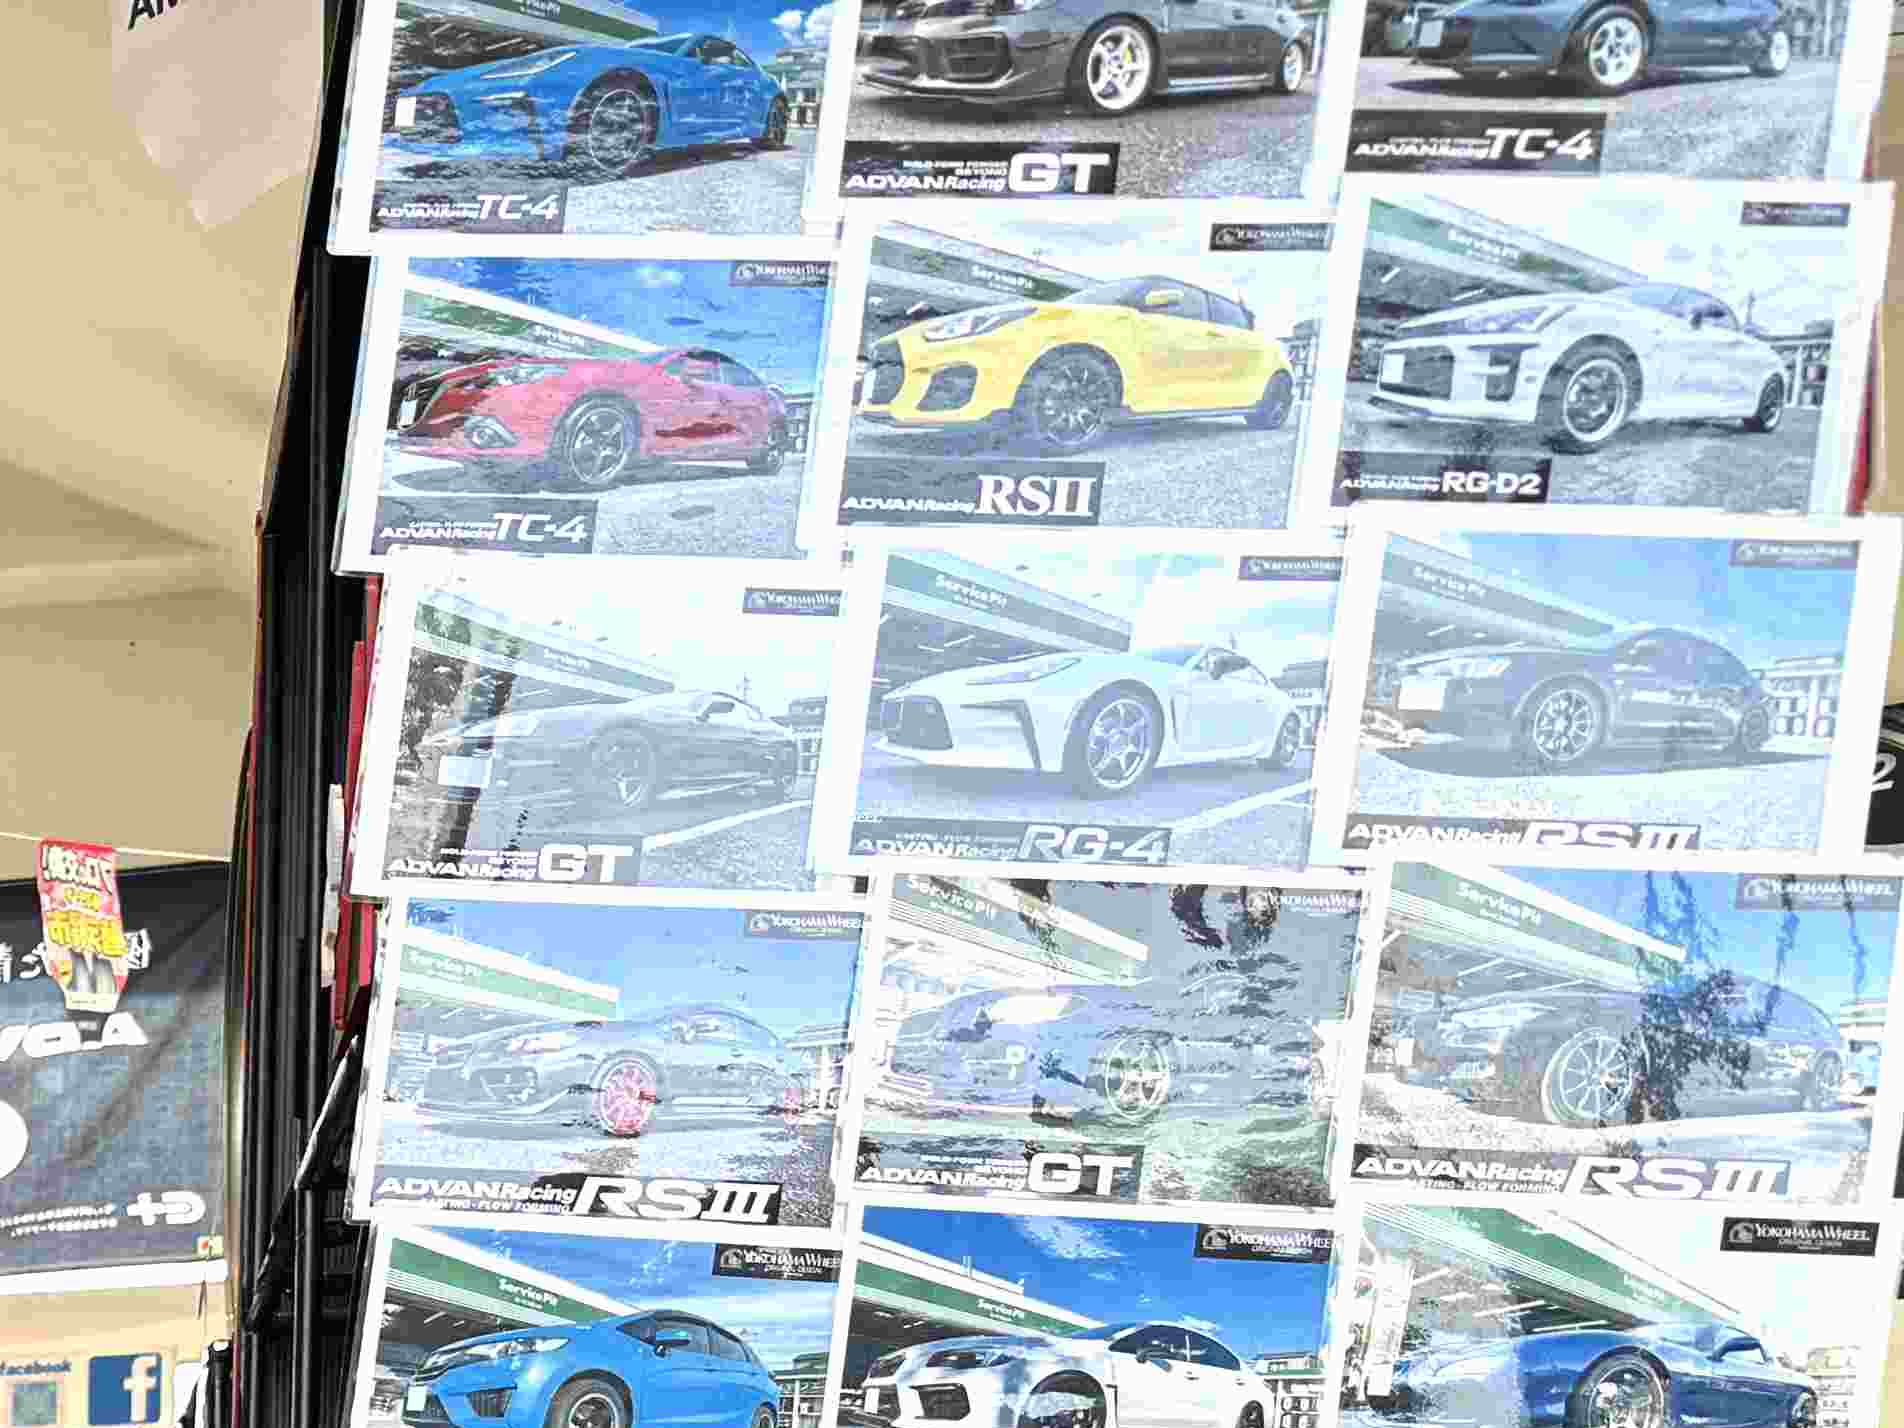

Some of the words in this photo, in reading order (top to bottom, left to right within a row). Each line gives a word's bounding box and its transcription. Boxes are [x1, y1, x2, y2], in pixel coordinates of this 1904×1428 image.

[1484, 128, 1596, 161] TC-4
[1008, 153, 1111, 193] GT
[478, 195, 560, 220] TC-4
[1442, 471, 1544, 497] RG-D2
[494, 513, 589, 542] TC-4
[1020, 824, 1169, 864] RG-4
[537, 842, 635, 883] GT
[1028, 1150, 1137, 1196] GT
